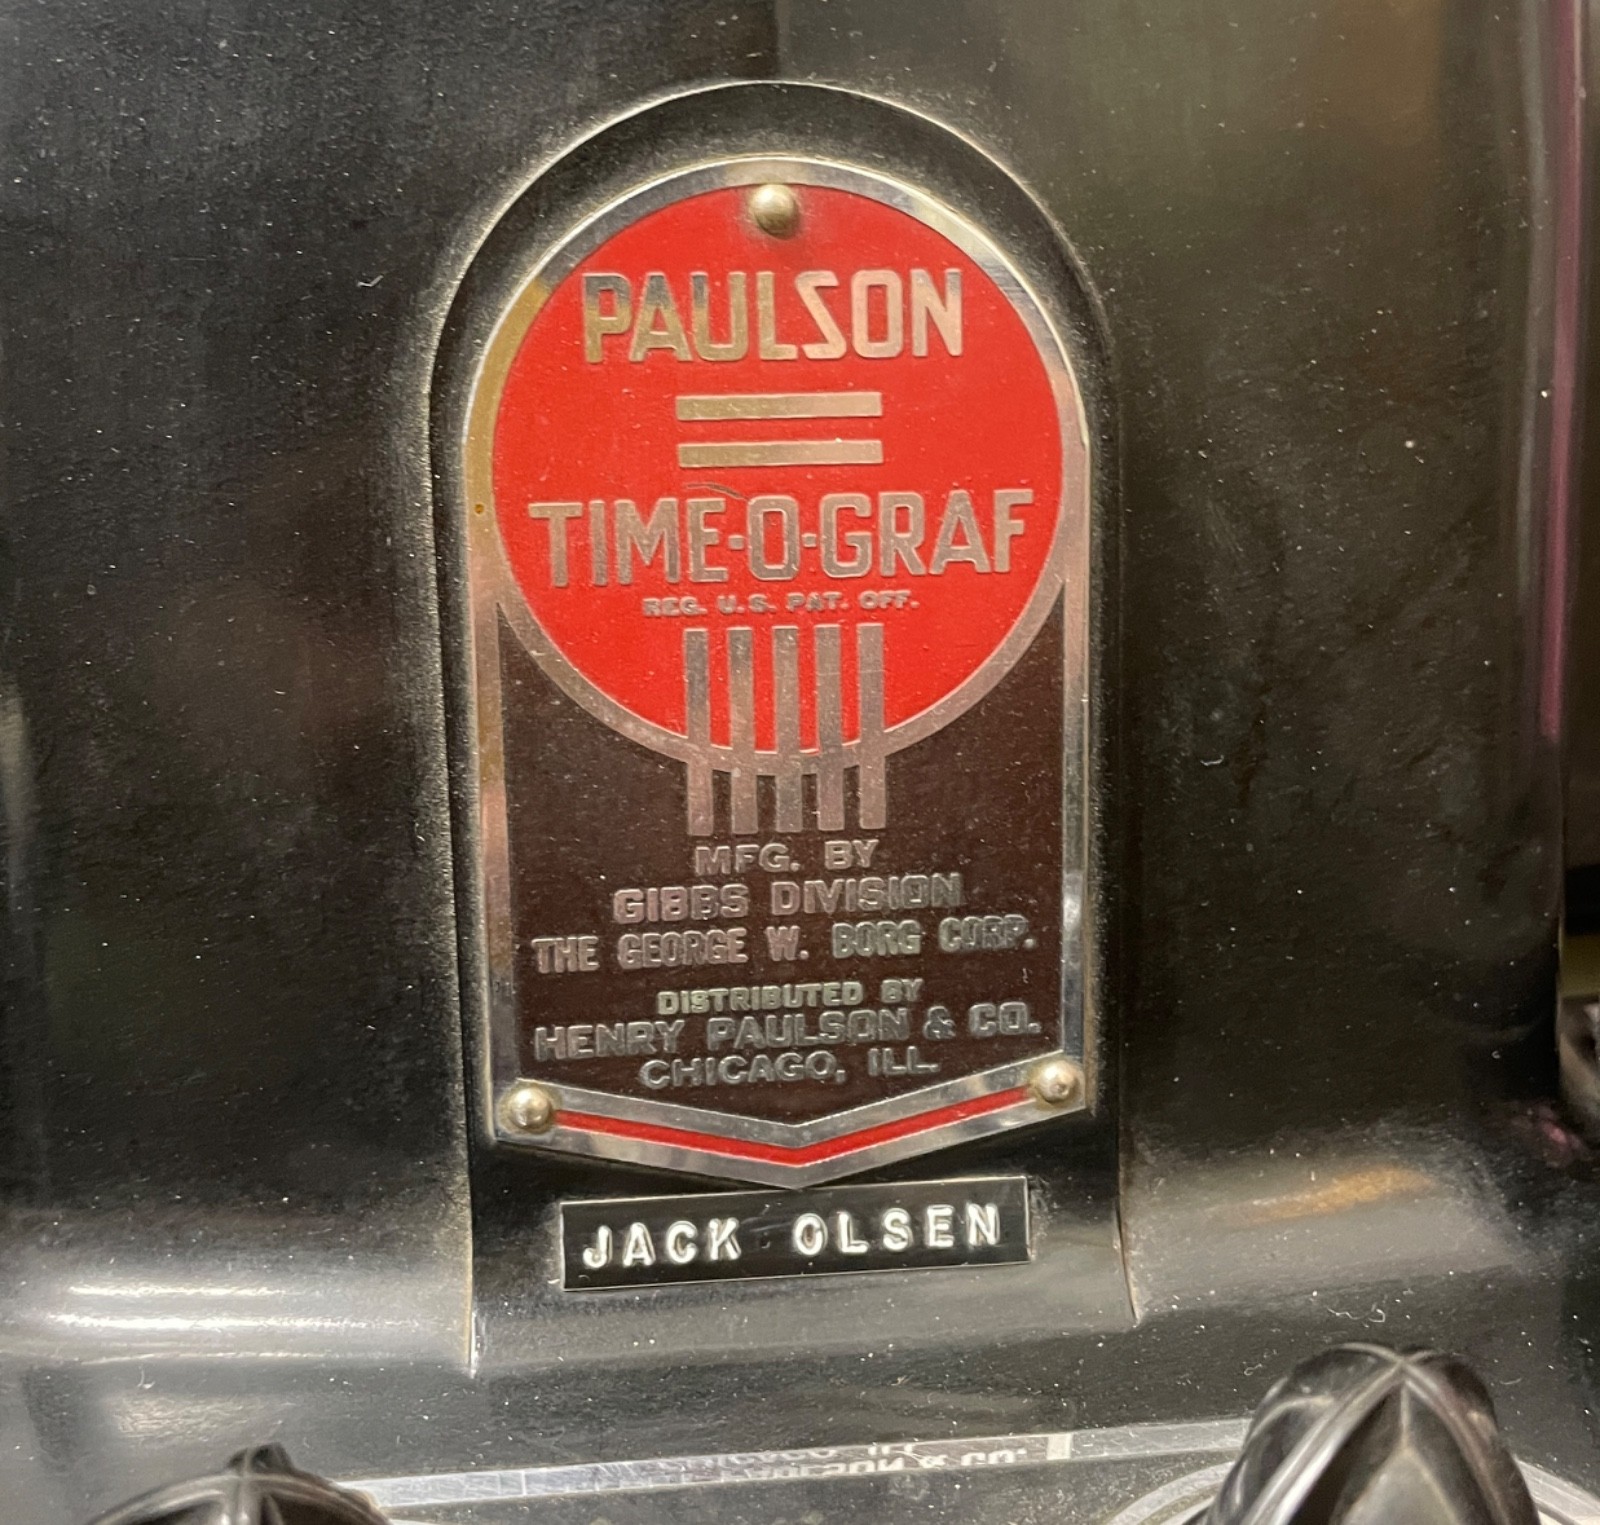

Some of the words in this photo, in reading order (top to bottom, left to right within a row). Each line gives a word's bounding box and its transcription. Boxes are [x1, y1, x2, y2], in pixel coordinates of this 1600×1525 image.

[581, 268, 964, 364] PAULSON
[643, 596, 708, 617] REG.
[786, 591, 849, 611] PAT.
[858, 589, 920, 610] OFF.
[694, 845, 800, 876] MFG.
[823, 838, 879, 870] BY
[612, 884, 750, 925] GIBBS
[770, 872, 964, 916] DIVISION
[531, 936, 599, 974] THE
[617, 928, 748, 970] GEORGE
[766, 926, 809, 961] W.
[831, 921, 922, 959] BORG
[939, 914, 1037, 953] CORP.
[657, 982, 864, 1016] DISTRIBUTED
[881, 978, 924, 1002] BY
[534, 1020, 686, 1062] HENRY
[706, 1009, 909, 1051] PAULSON
[923, 1005, 956, 1040] &
[968, 1001, 1043, 1036] CO.
[582, 1218, 742, 1269] JACK
[792, 1203, 1000, 1256] OLSEN
